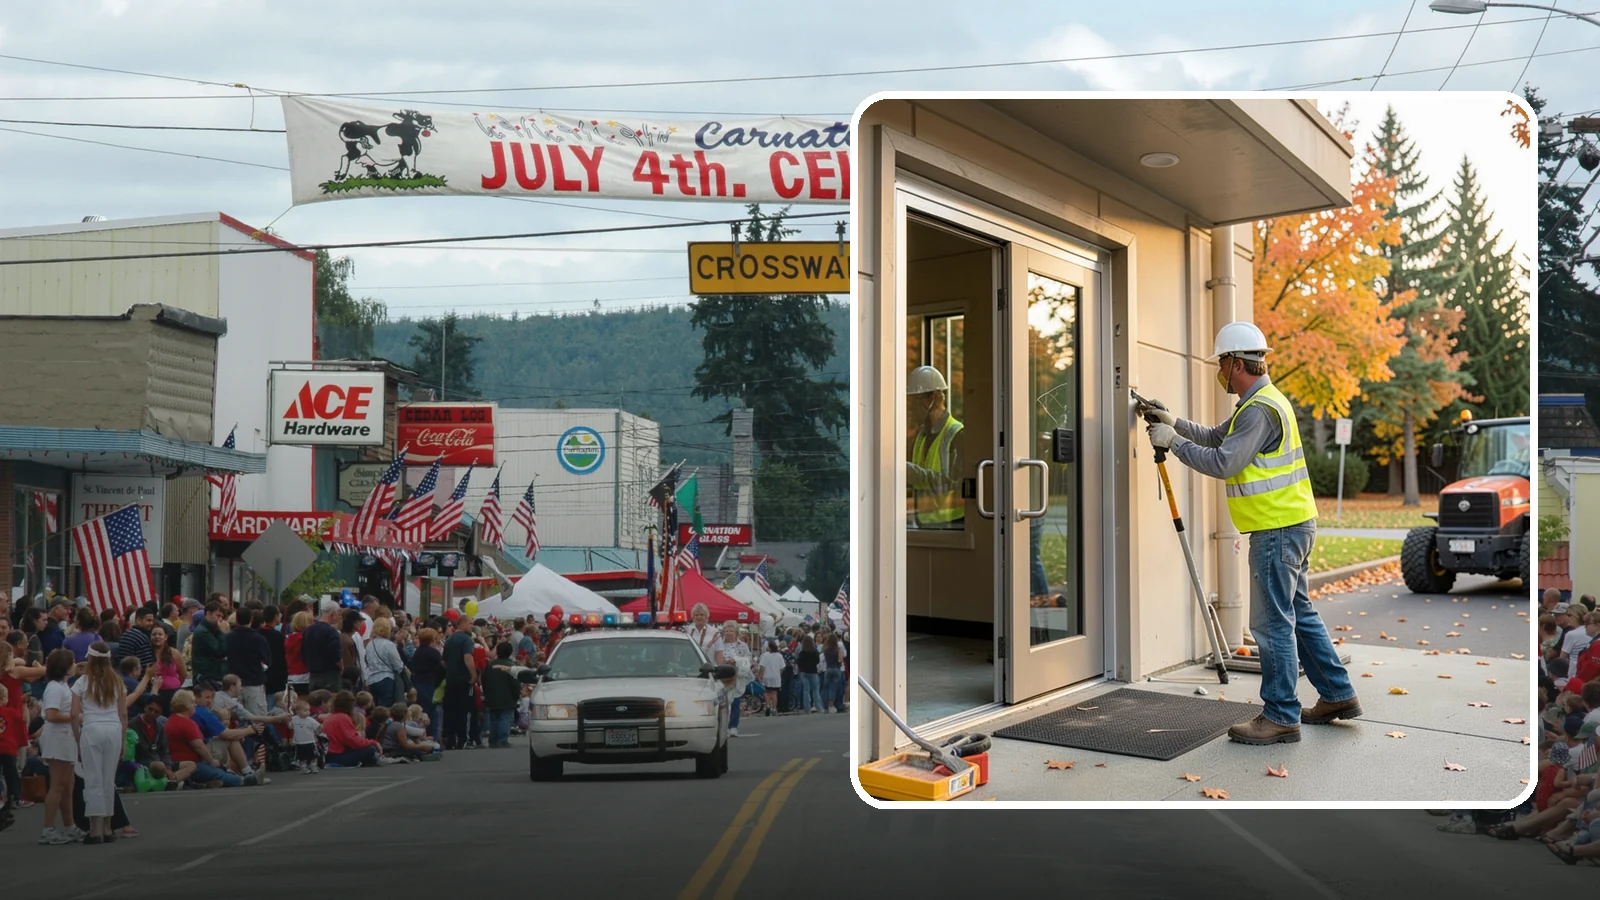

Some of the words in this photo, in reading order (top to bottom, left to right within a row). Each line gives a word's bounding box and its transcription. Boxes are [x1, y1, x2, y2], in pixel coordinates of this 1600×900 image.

[481, 140, 605, 192] JULY
[632, 149, 746, 197] 4th.
[697, 254, 850, 280] CROSSWA
[282, 380, 373, 420] ACE
[405, 409, 452, 421] CEDAR
[461, 409, 484, 421] LOG
[283, 421, 371, 436] Hardware
[416, 428, 477, 446] Coca-Cola
[83, 484, 93, 494] St.
[95, 485, 124, 494] Vincent
[126, 486, 136, 494] de
[138, 486, 155, 495] Paul
[688, 526, 741, 535] CRNATION
[699, 535, 730, 543] GLASS
